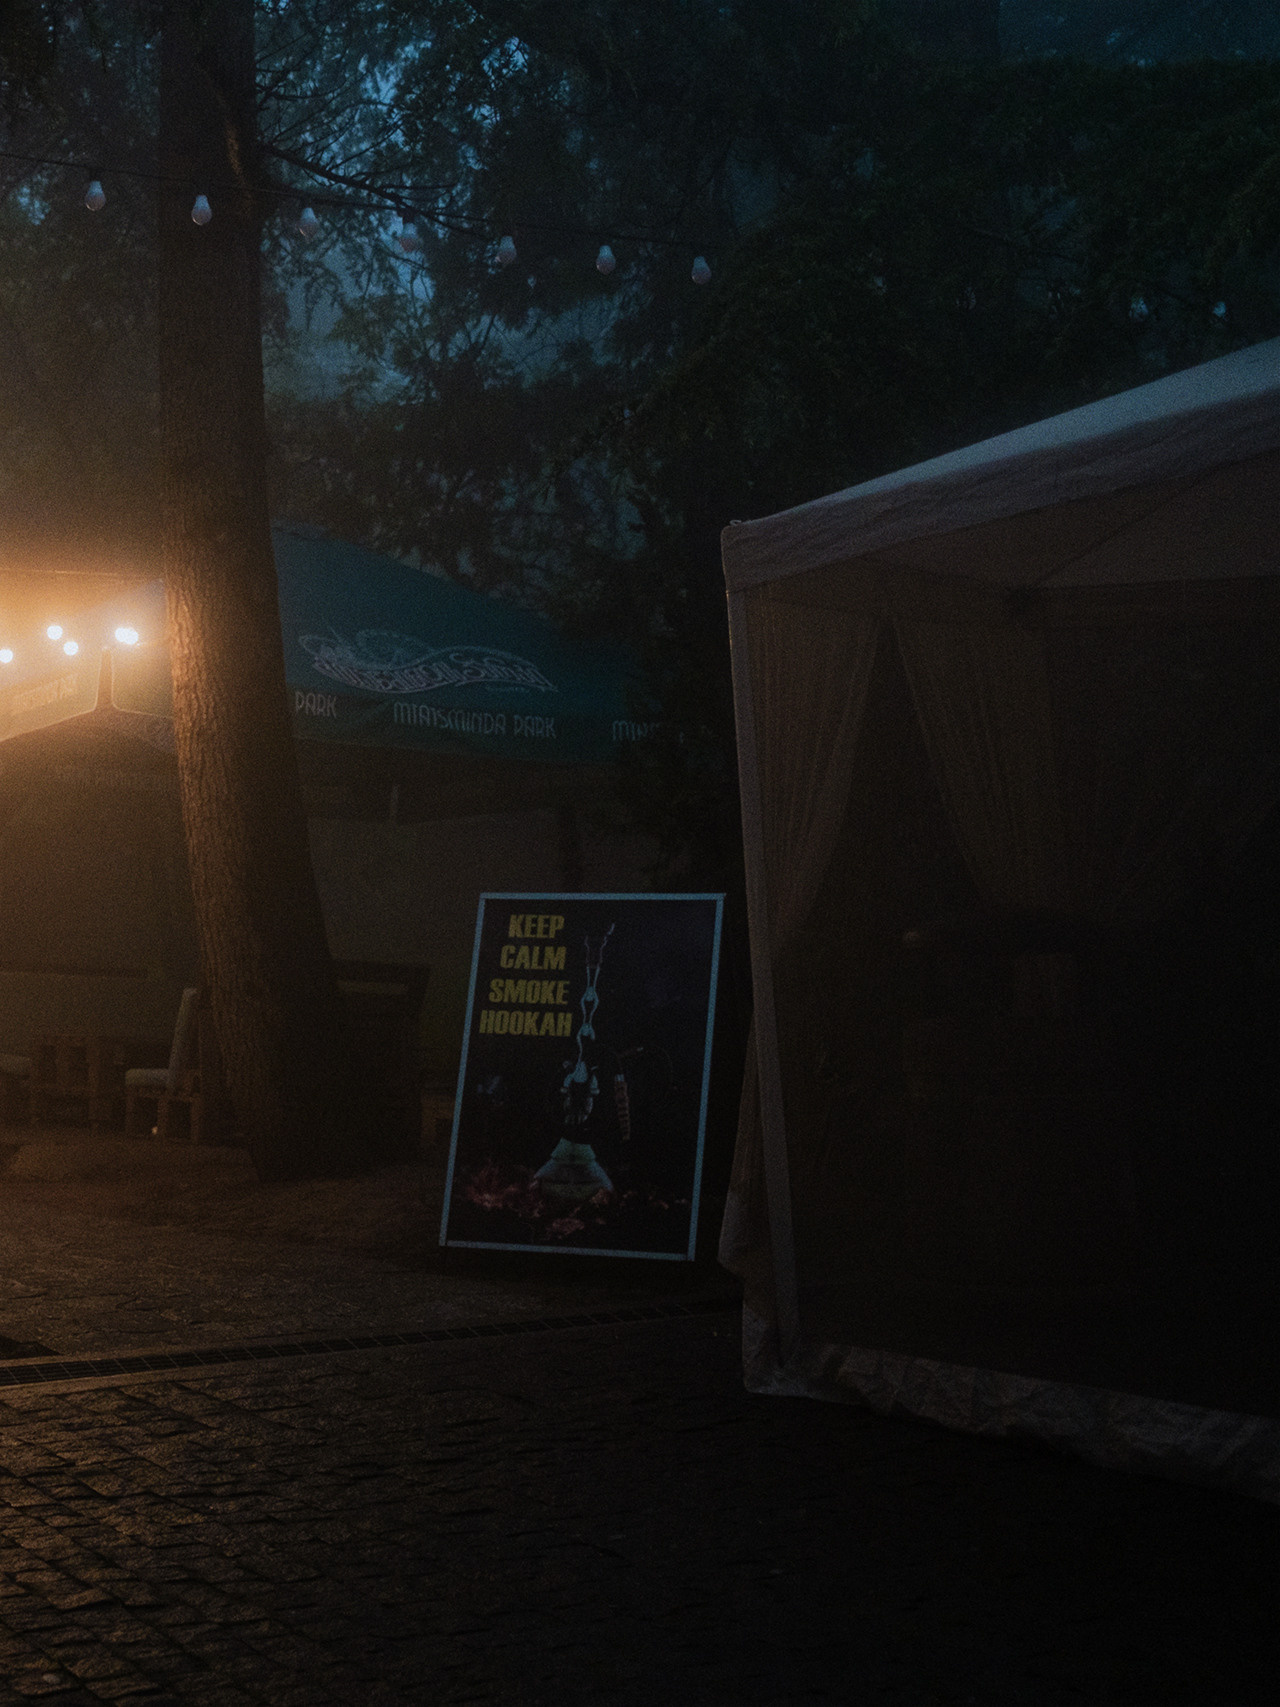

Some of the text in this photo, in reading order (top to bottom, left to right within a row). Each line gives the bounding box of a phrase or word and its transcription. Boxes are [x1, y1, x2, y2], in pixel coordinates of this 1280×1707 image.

[294, 690, 338, 719] PARK
[513, 714, 557, 739] PARK
[508, 914, 565, 939] KEEP
[500, 945, 567, 970] CALM
[489, 979, 570, 1005] SMOKE
[479, 1010, 573, 1037] HOOKAH
